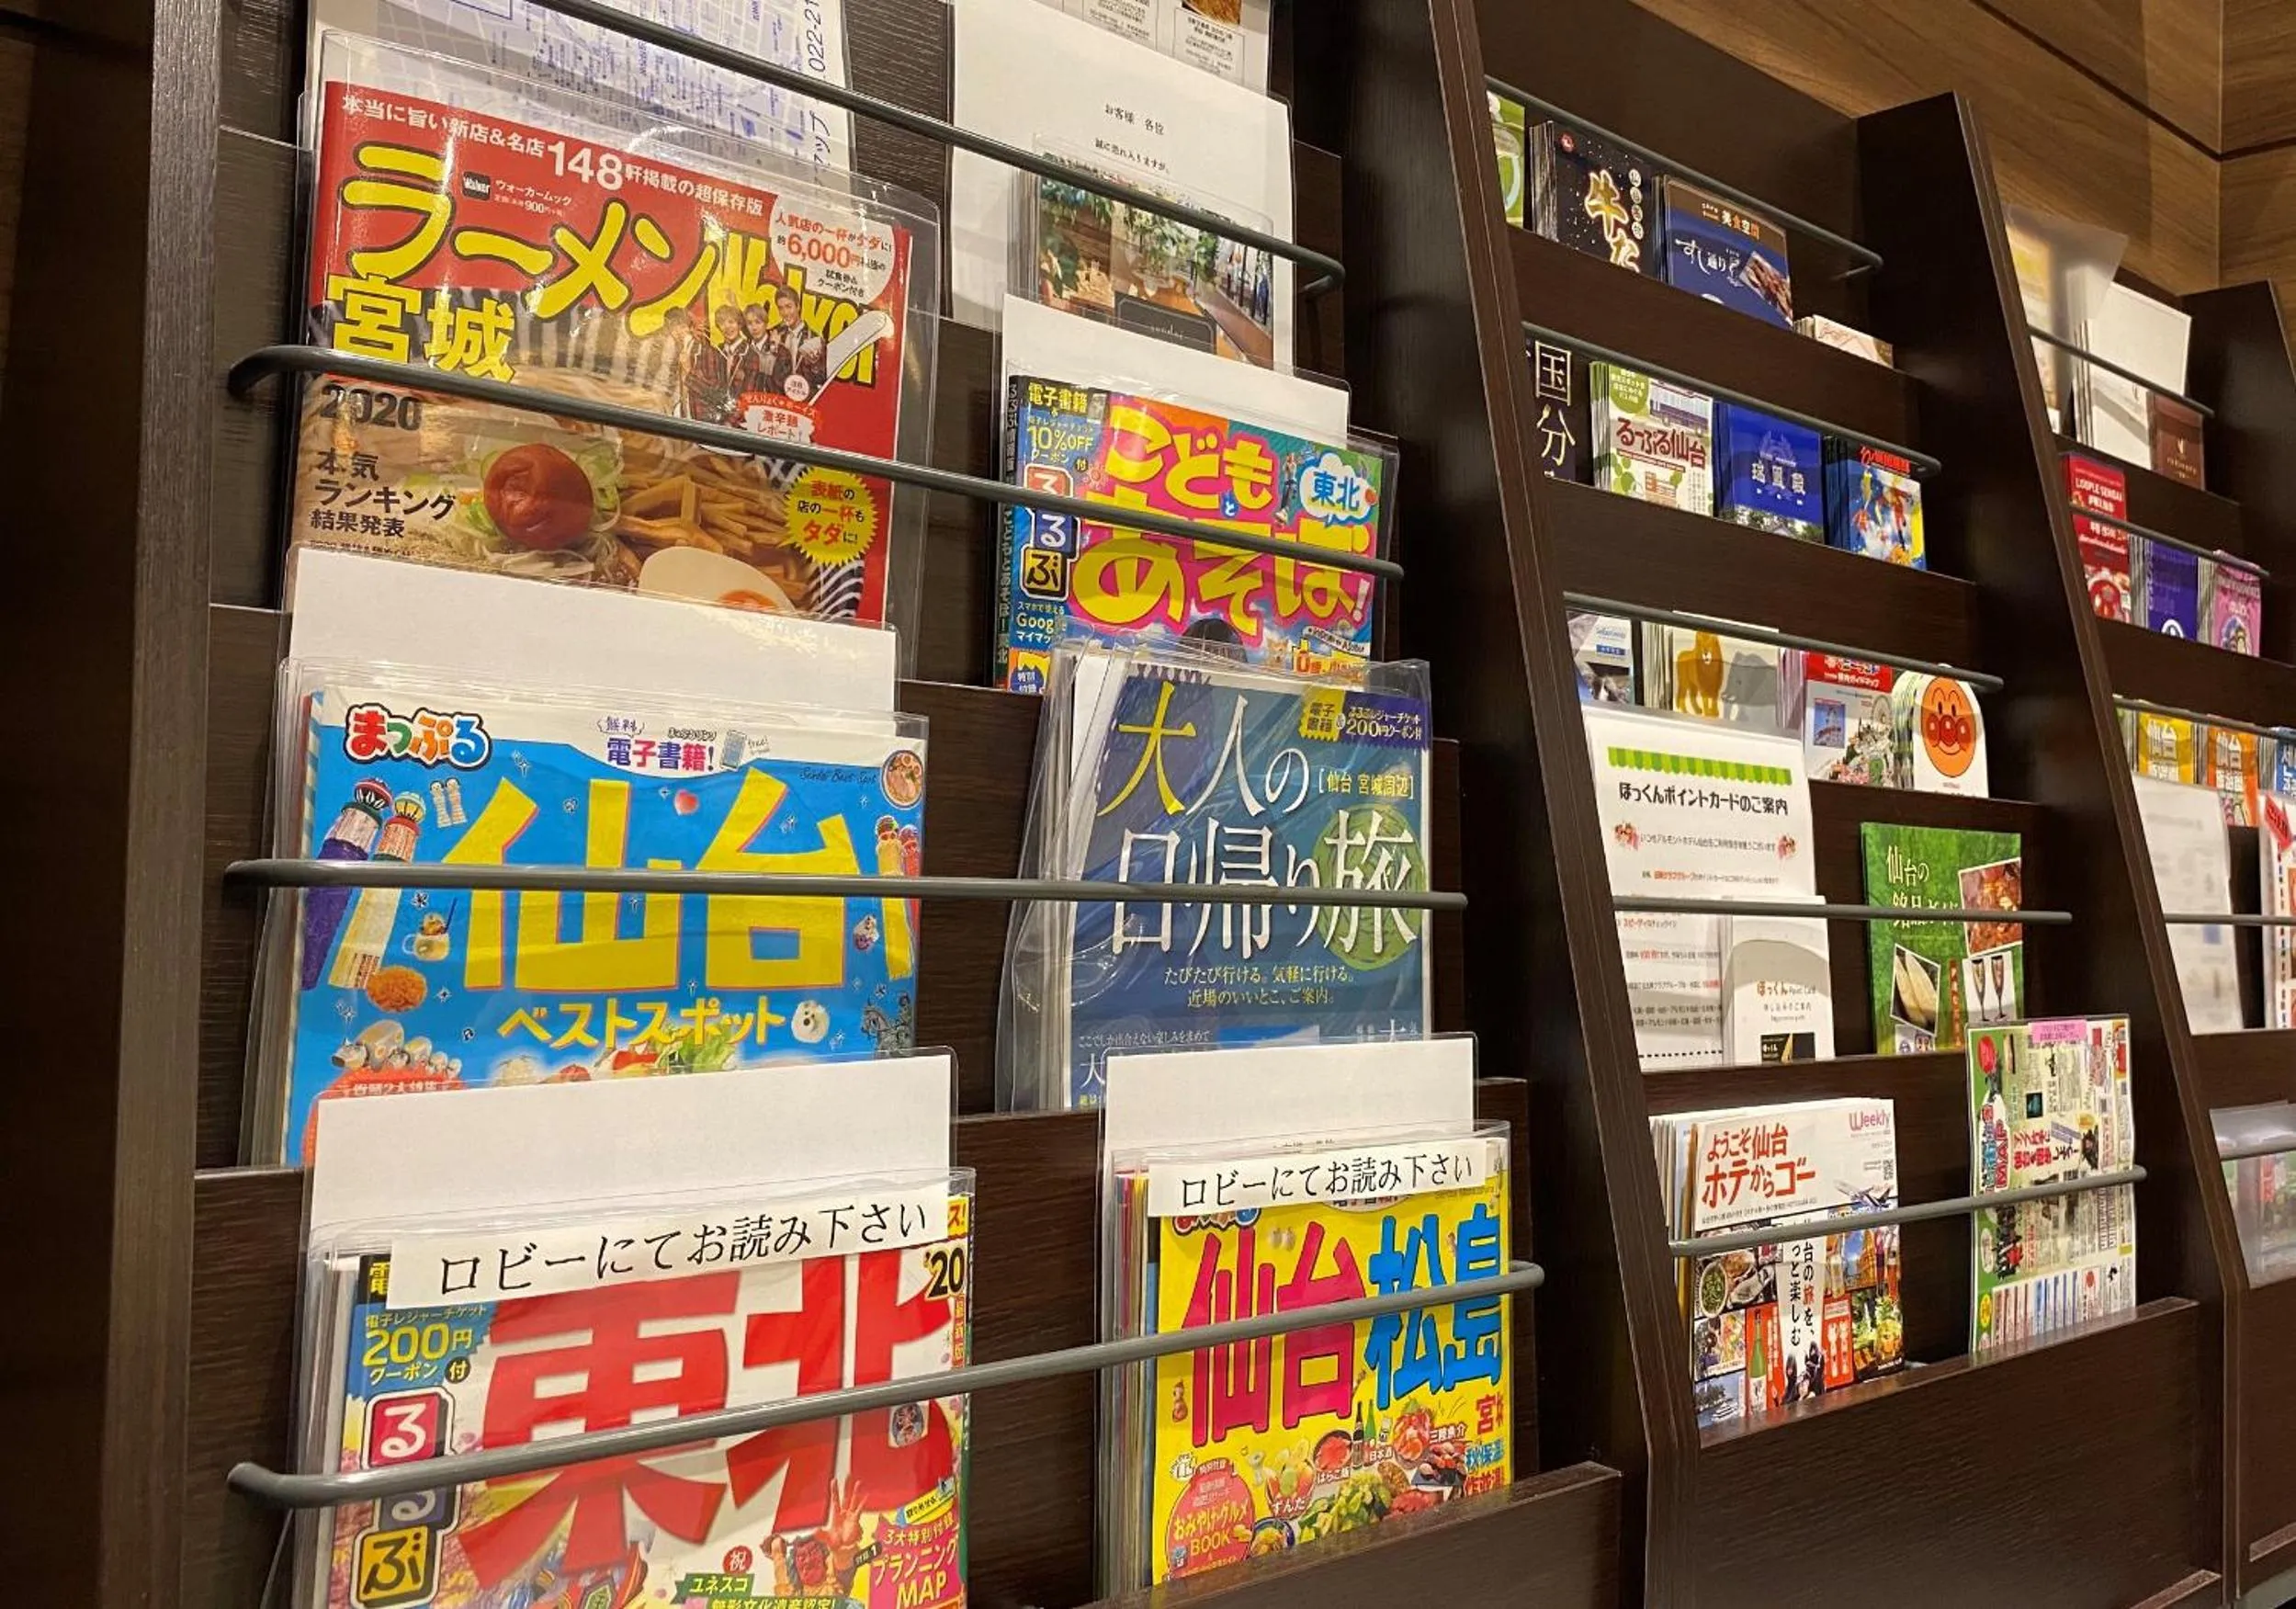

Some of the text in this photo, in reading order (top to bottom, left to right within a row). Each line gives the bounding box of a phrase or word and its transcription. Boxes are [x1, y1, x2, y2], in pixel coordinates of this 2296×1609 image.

[495, 179, 572, 207] ウォーカームック
[340, 140, 719, 340] ラーメン
[327, 272, 516, 384] 宮城
[319, 385, 423, 432] 2020
[1028, 381, 1088, 414] 電子書籍
[1534, 339, 1577, 477] 国分
[1027, 425, 1094, 452] 10%OFF
[1103, 404, 1273, 511] こども
[1615, 415, 1707, 470] るーぷる仙台
[316, 448, 379, 482] 本気
[314, 478, 457, 521] ランキング
[809, 479, 856, 502] 表紙の
[1311, 469, 1361, 512] 東北
[309, 508, 405, 538] 結果発表
[796, 501, 865, 525] 店の一杯も
[802, 522, 859, 547] タダに!
[345, 704, 491, 767] まっぷる
[605, 736, 716, 774] 電子書籍!
[1096, 680, 1310, 818] 大人の
[1618, 781, 1789, 817] ほっくんポイントカードのご案内
[440, 765, 862, 992] 仙台
[1111, 810, 1419, 960] 日帰り旅
[1186, 988, 1335, 1009] 近場のいいとこ、ご案内。
[497, 994, 786, 1049] ベストスポット
[1706, 1122, 1789, 1162] ようこそ仙台
[1849, 1109, 1892, 1132] Weekly
[1181, 1152, 1474, 1209] ロビーにてお読み下さい
[1702, 1156, 1816, 1209] ホテからゴー
[441, 1201, 927, 1297] ロビーにてお読み下さい
[923, 1247, 966, 1298] '20
[365, 1304, 487, 1329] 電子レジャーチケット
[1363, 1202, 1501, 1411] 松島
[362, 1321, 473, 1367] 200円
[1181, 1219, 1367, 1448] 仙台
[369, 1360, 468, 1387] クーポン 付
[729, 1550, 747, 1572] 祝
[872, 1537, 957, 1587] プランニング
[1189, 1529, 1231, 1558] BOOK
[688, 1575, 749, 1595] ユネスコ
[896, 1569, 947, 1609] MAP
